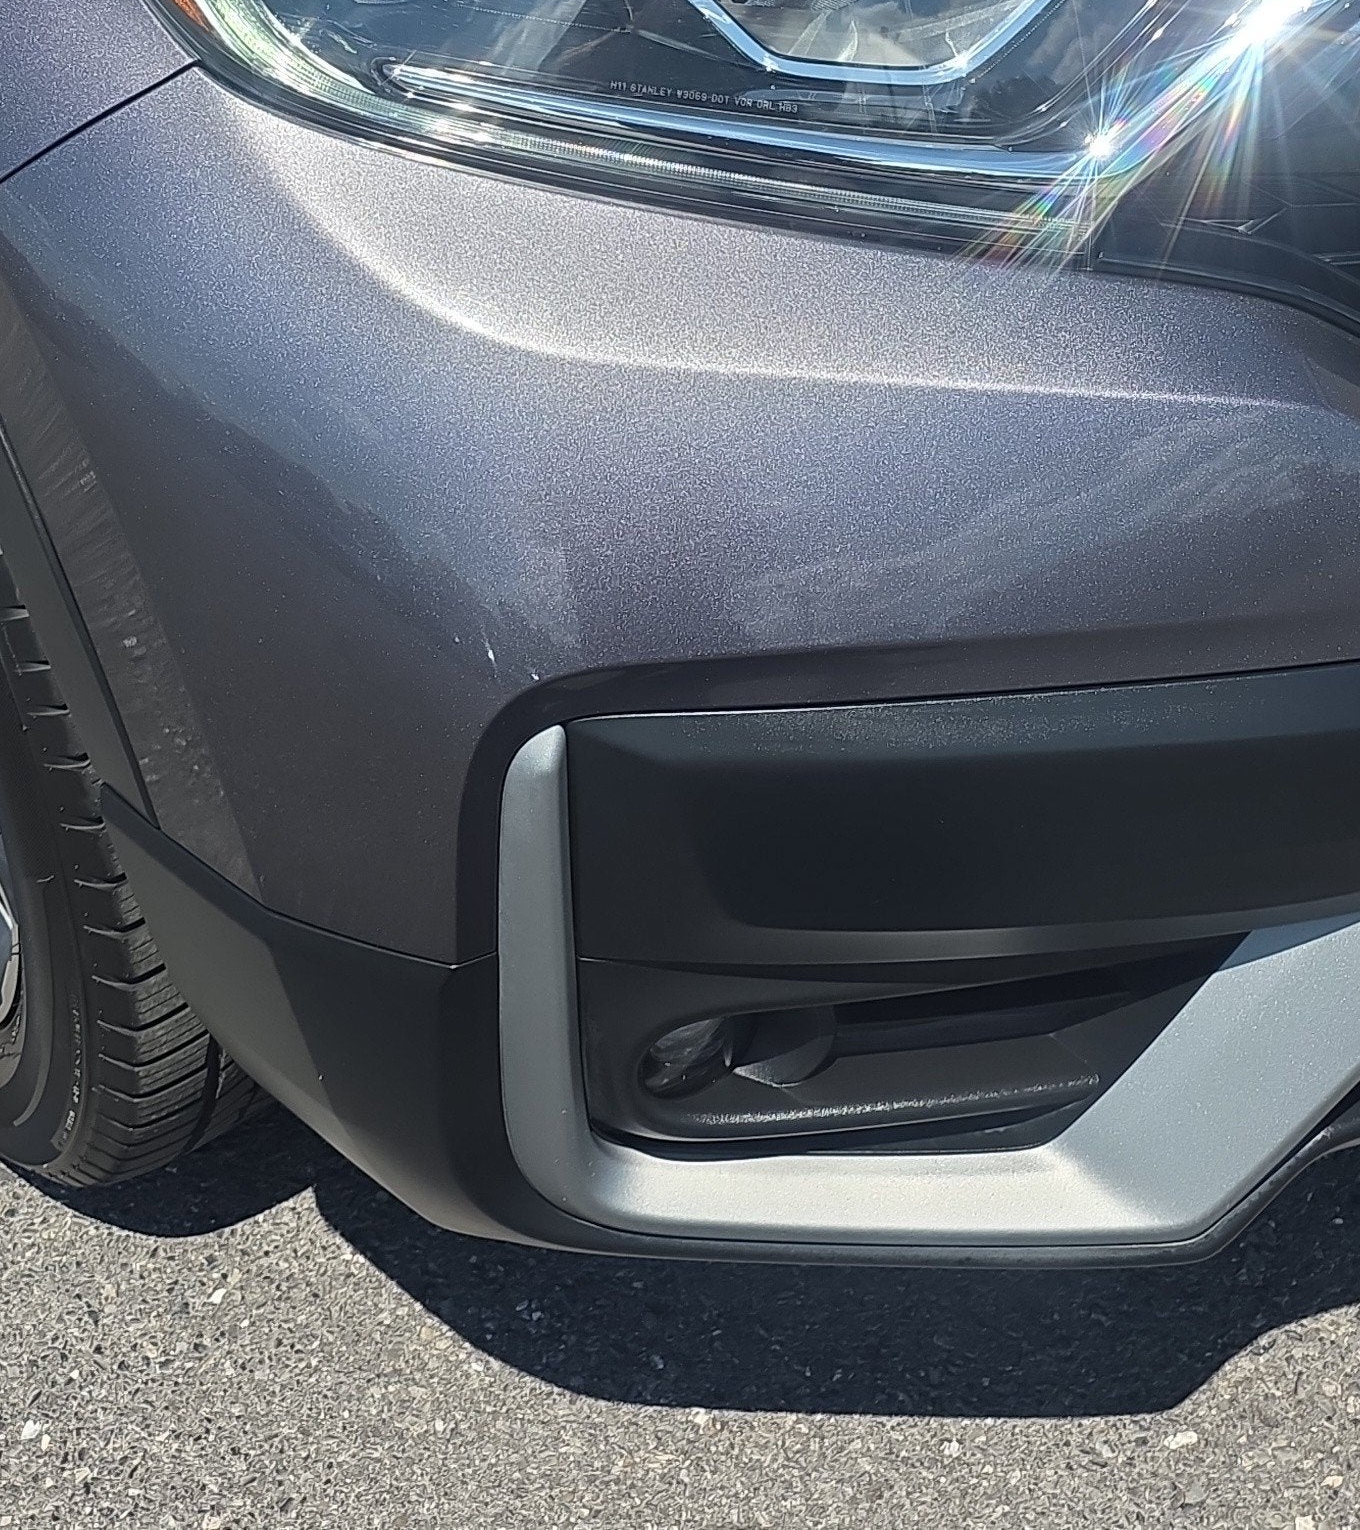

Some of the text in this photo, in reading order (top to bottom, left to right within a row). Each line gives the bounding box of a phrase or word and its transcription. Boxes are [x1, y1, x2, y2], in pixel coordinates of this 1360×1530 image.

[610, 80, 627, 91] H11
[629, 83, 673, 97] STANLEY
[711, 95, 730, 105] DOT
